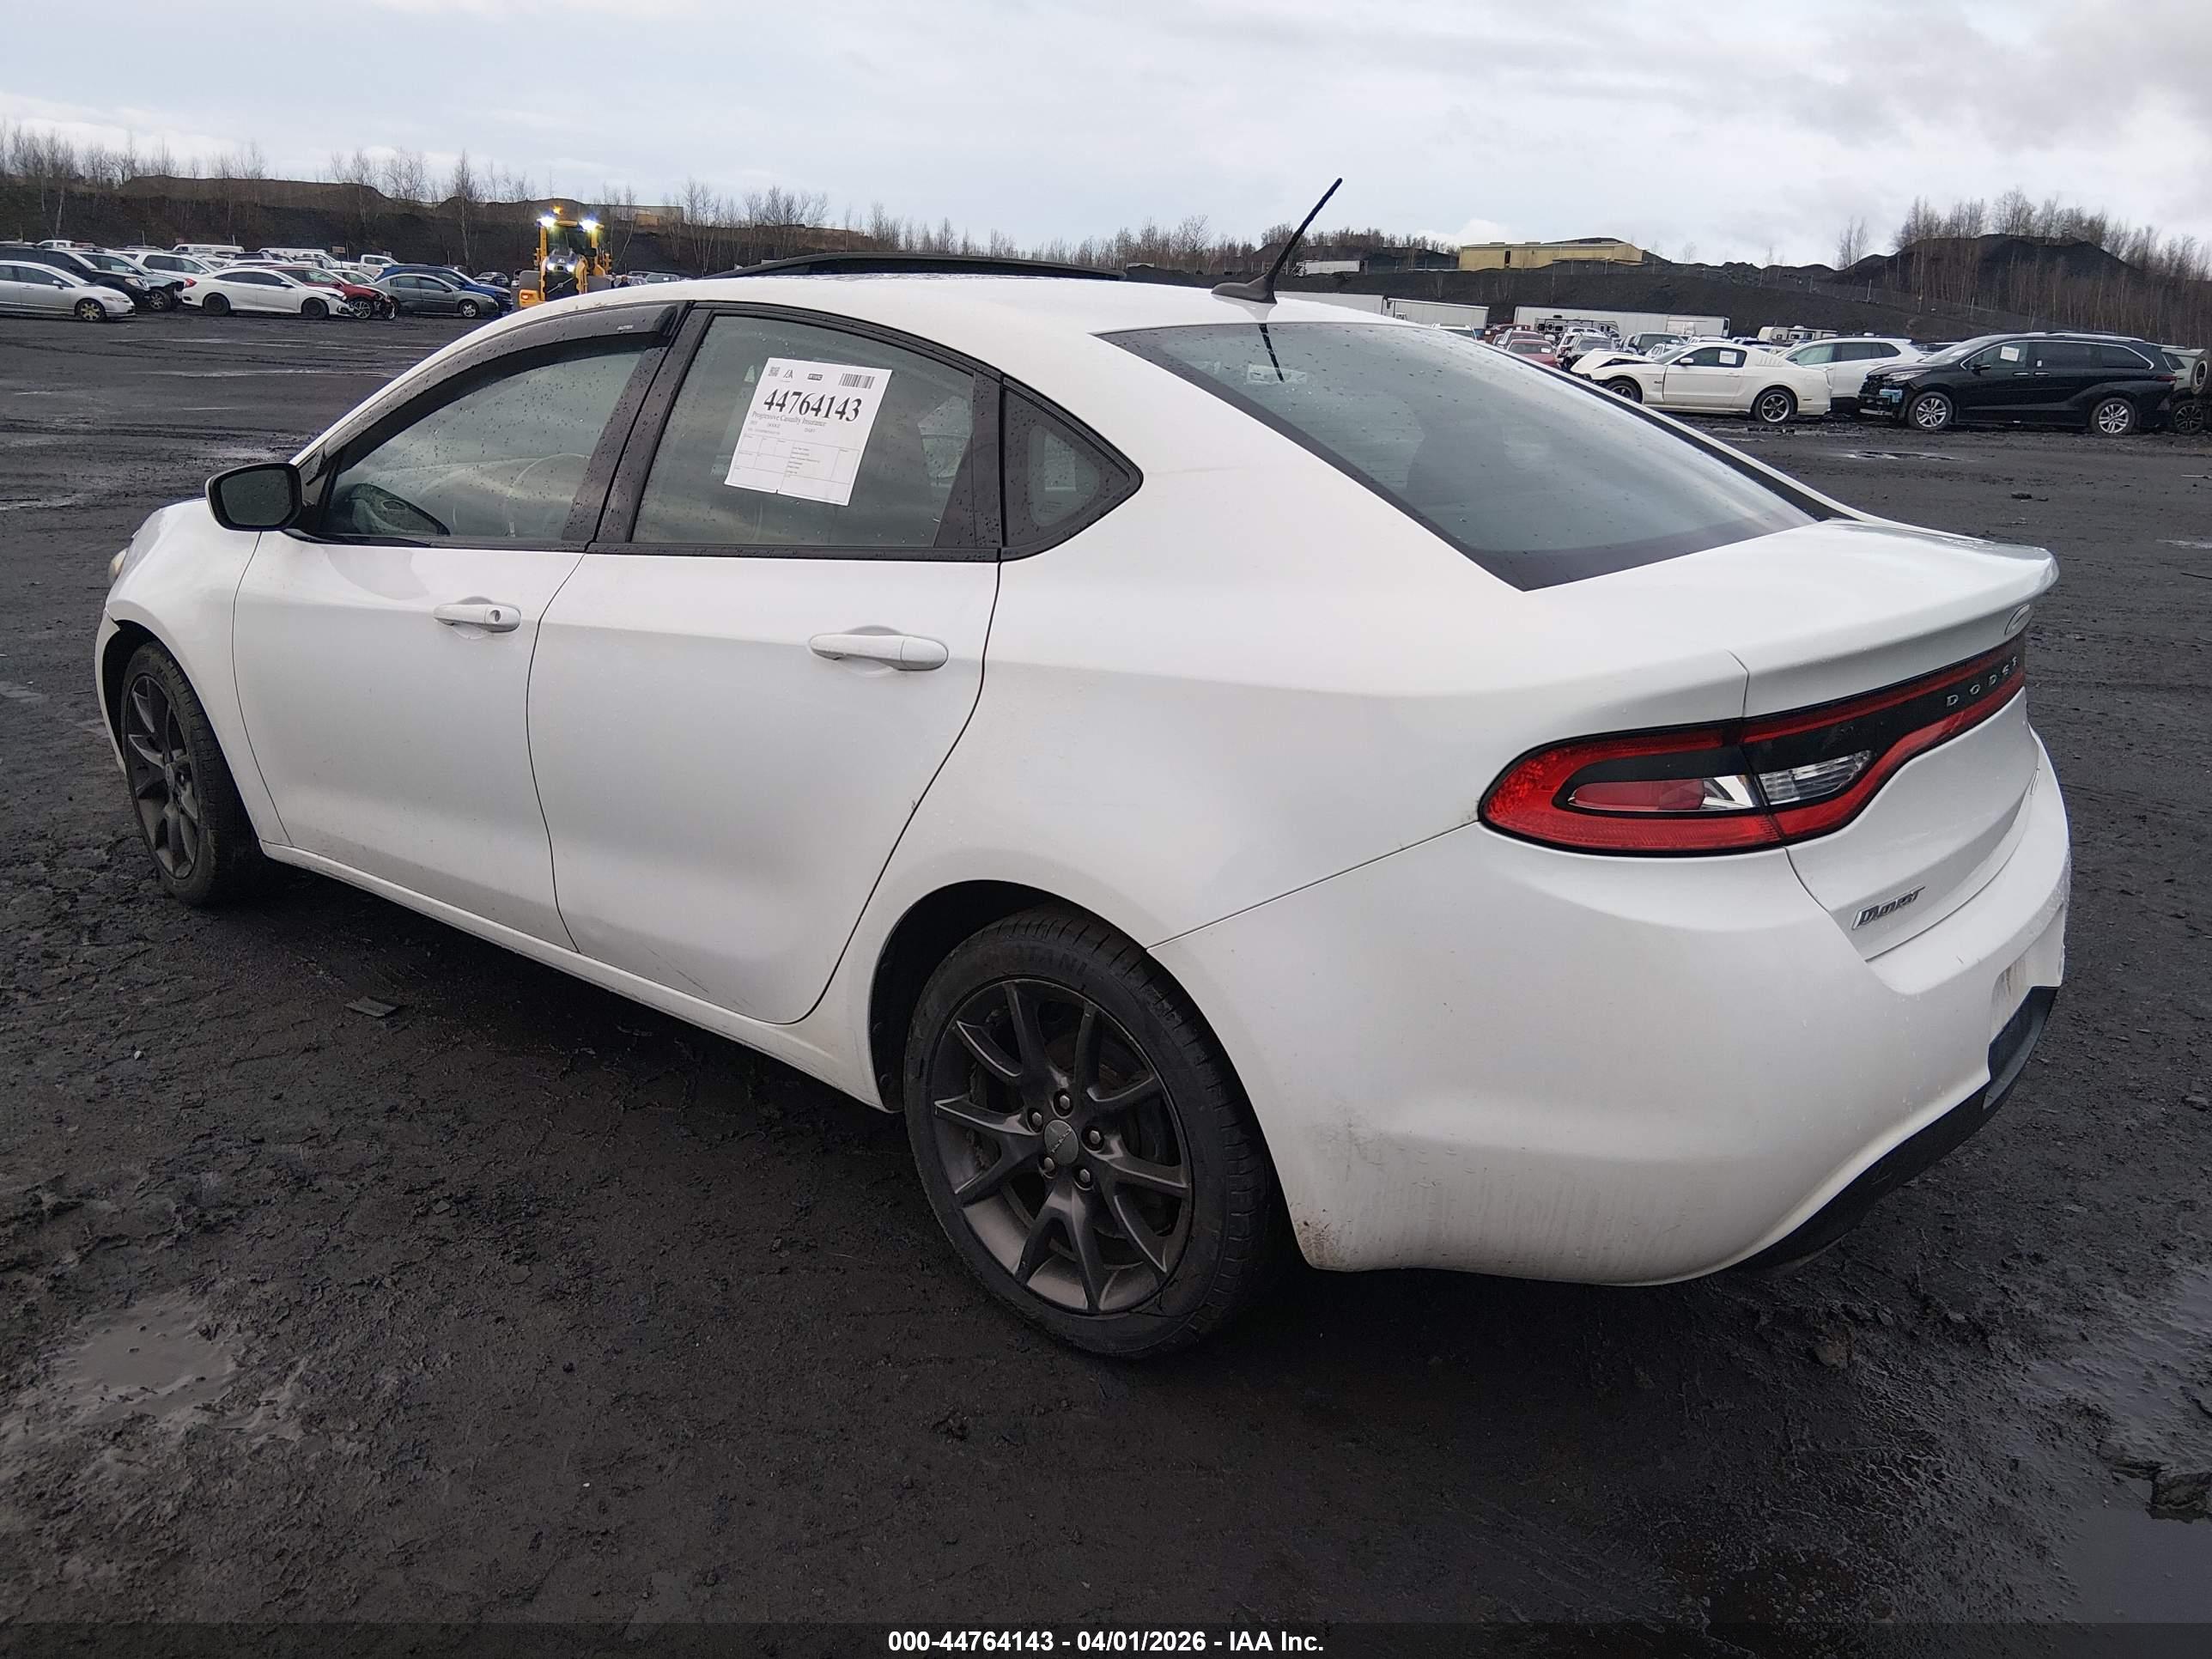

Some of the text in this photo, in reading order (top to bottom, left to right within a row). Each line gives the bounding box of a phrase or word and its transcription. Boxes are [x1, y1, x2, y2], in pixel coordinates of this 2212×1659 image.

[763, 388, 862, 422] 44764143
[751, 410, 827, 427] Progressive Casualty Insurance
